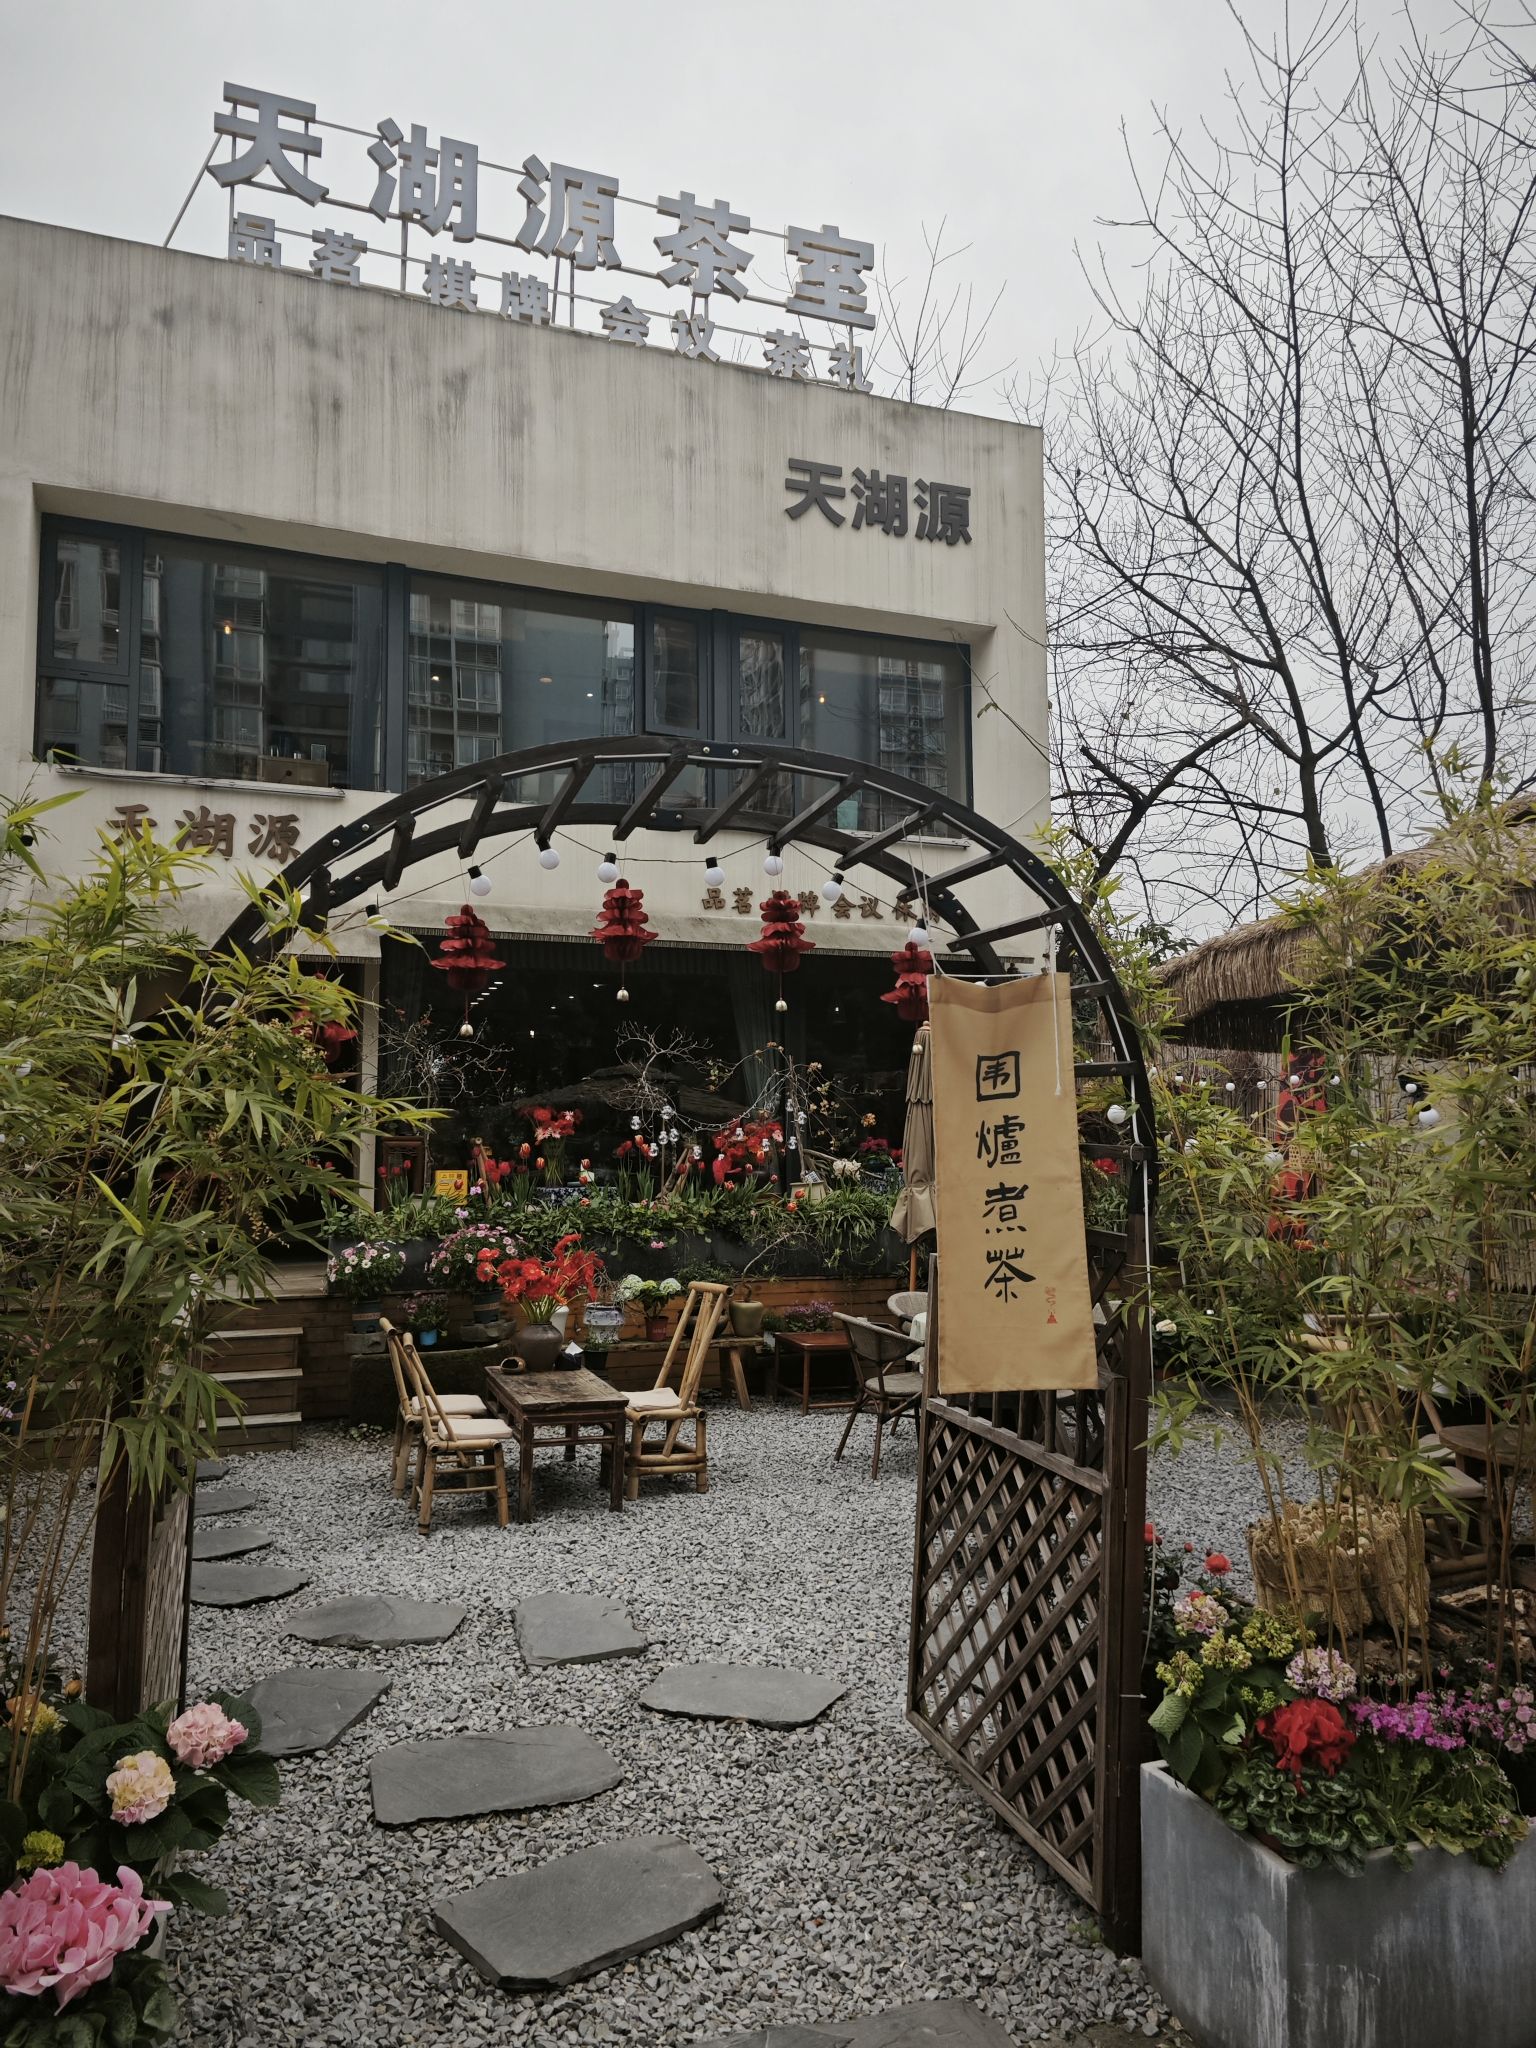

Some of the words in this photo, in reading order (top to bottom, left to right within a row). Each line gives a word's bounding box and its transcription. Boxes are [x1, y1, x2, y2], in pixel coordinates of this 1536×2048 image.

[207, 81, 876, 330] 天湖源茶室
[785, 458, 972, 545] 天湖源
[102, 804, 300, 864] 天湖源
